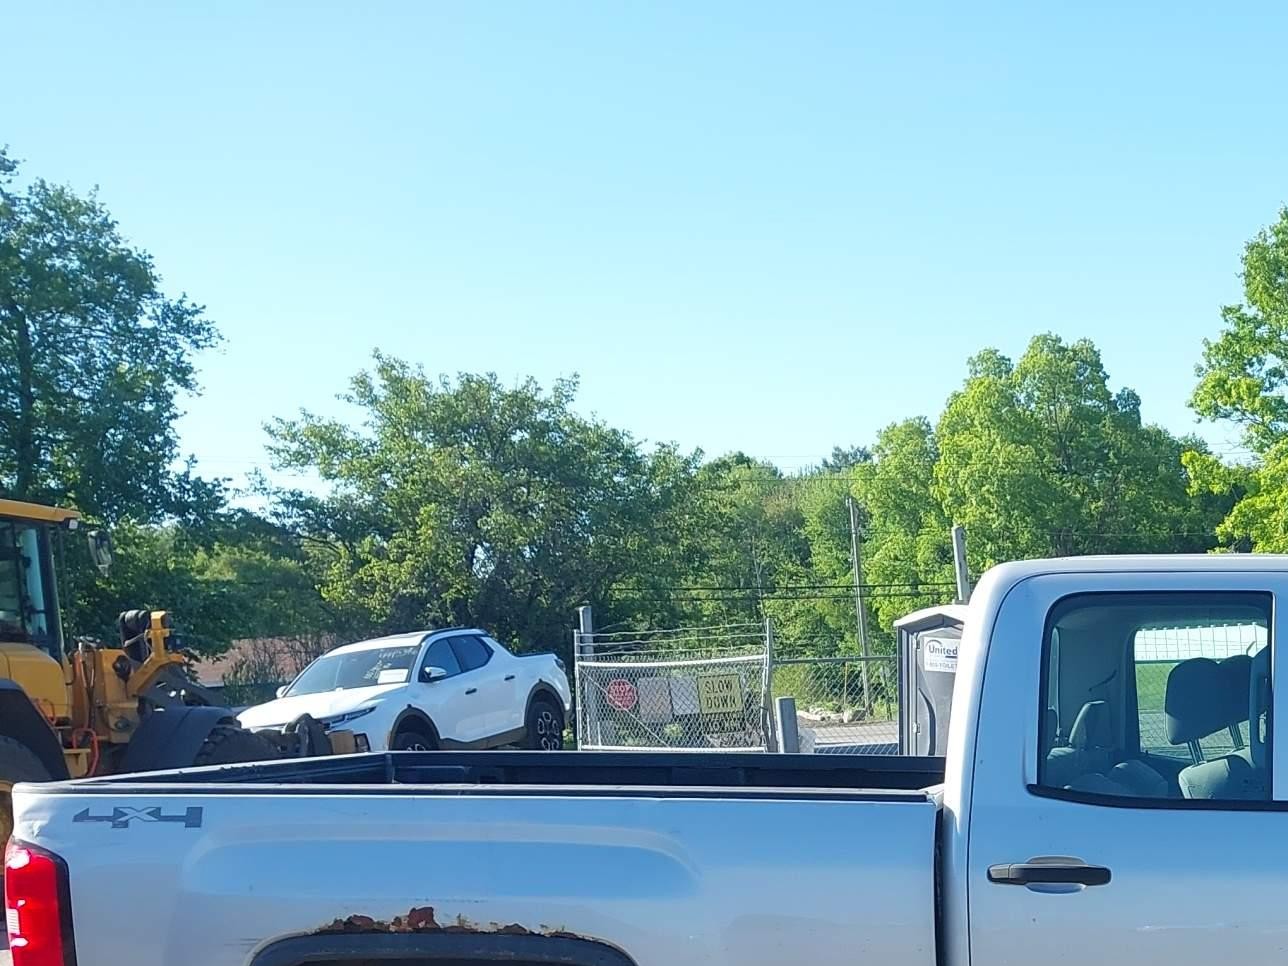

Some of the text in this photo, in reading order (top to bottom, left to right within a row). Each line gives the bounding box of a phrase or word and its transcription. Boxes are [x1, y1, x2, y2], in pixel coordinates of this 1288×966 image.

[928, 644, 958, 656] United
[704, 679, 733, 694] SLOW
[706, 695, 737, 709] DOWN
